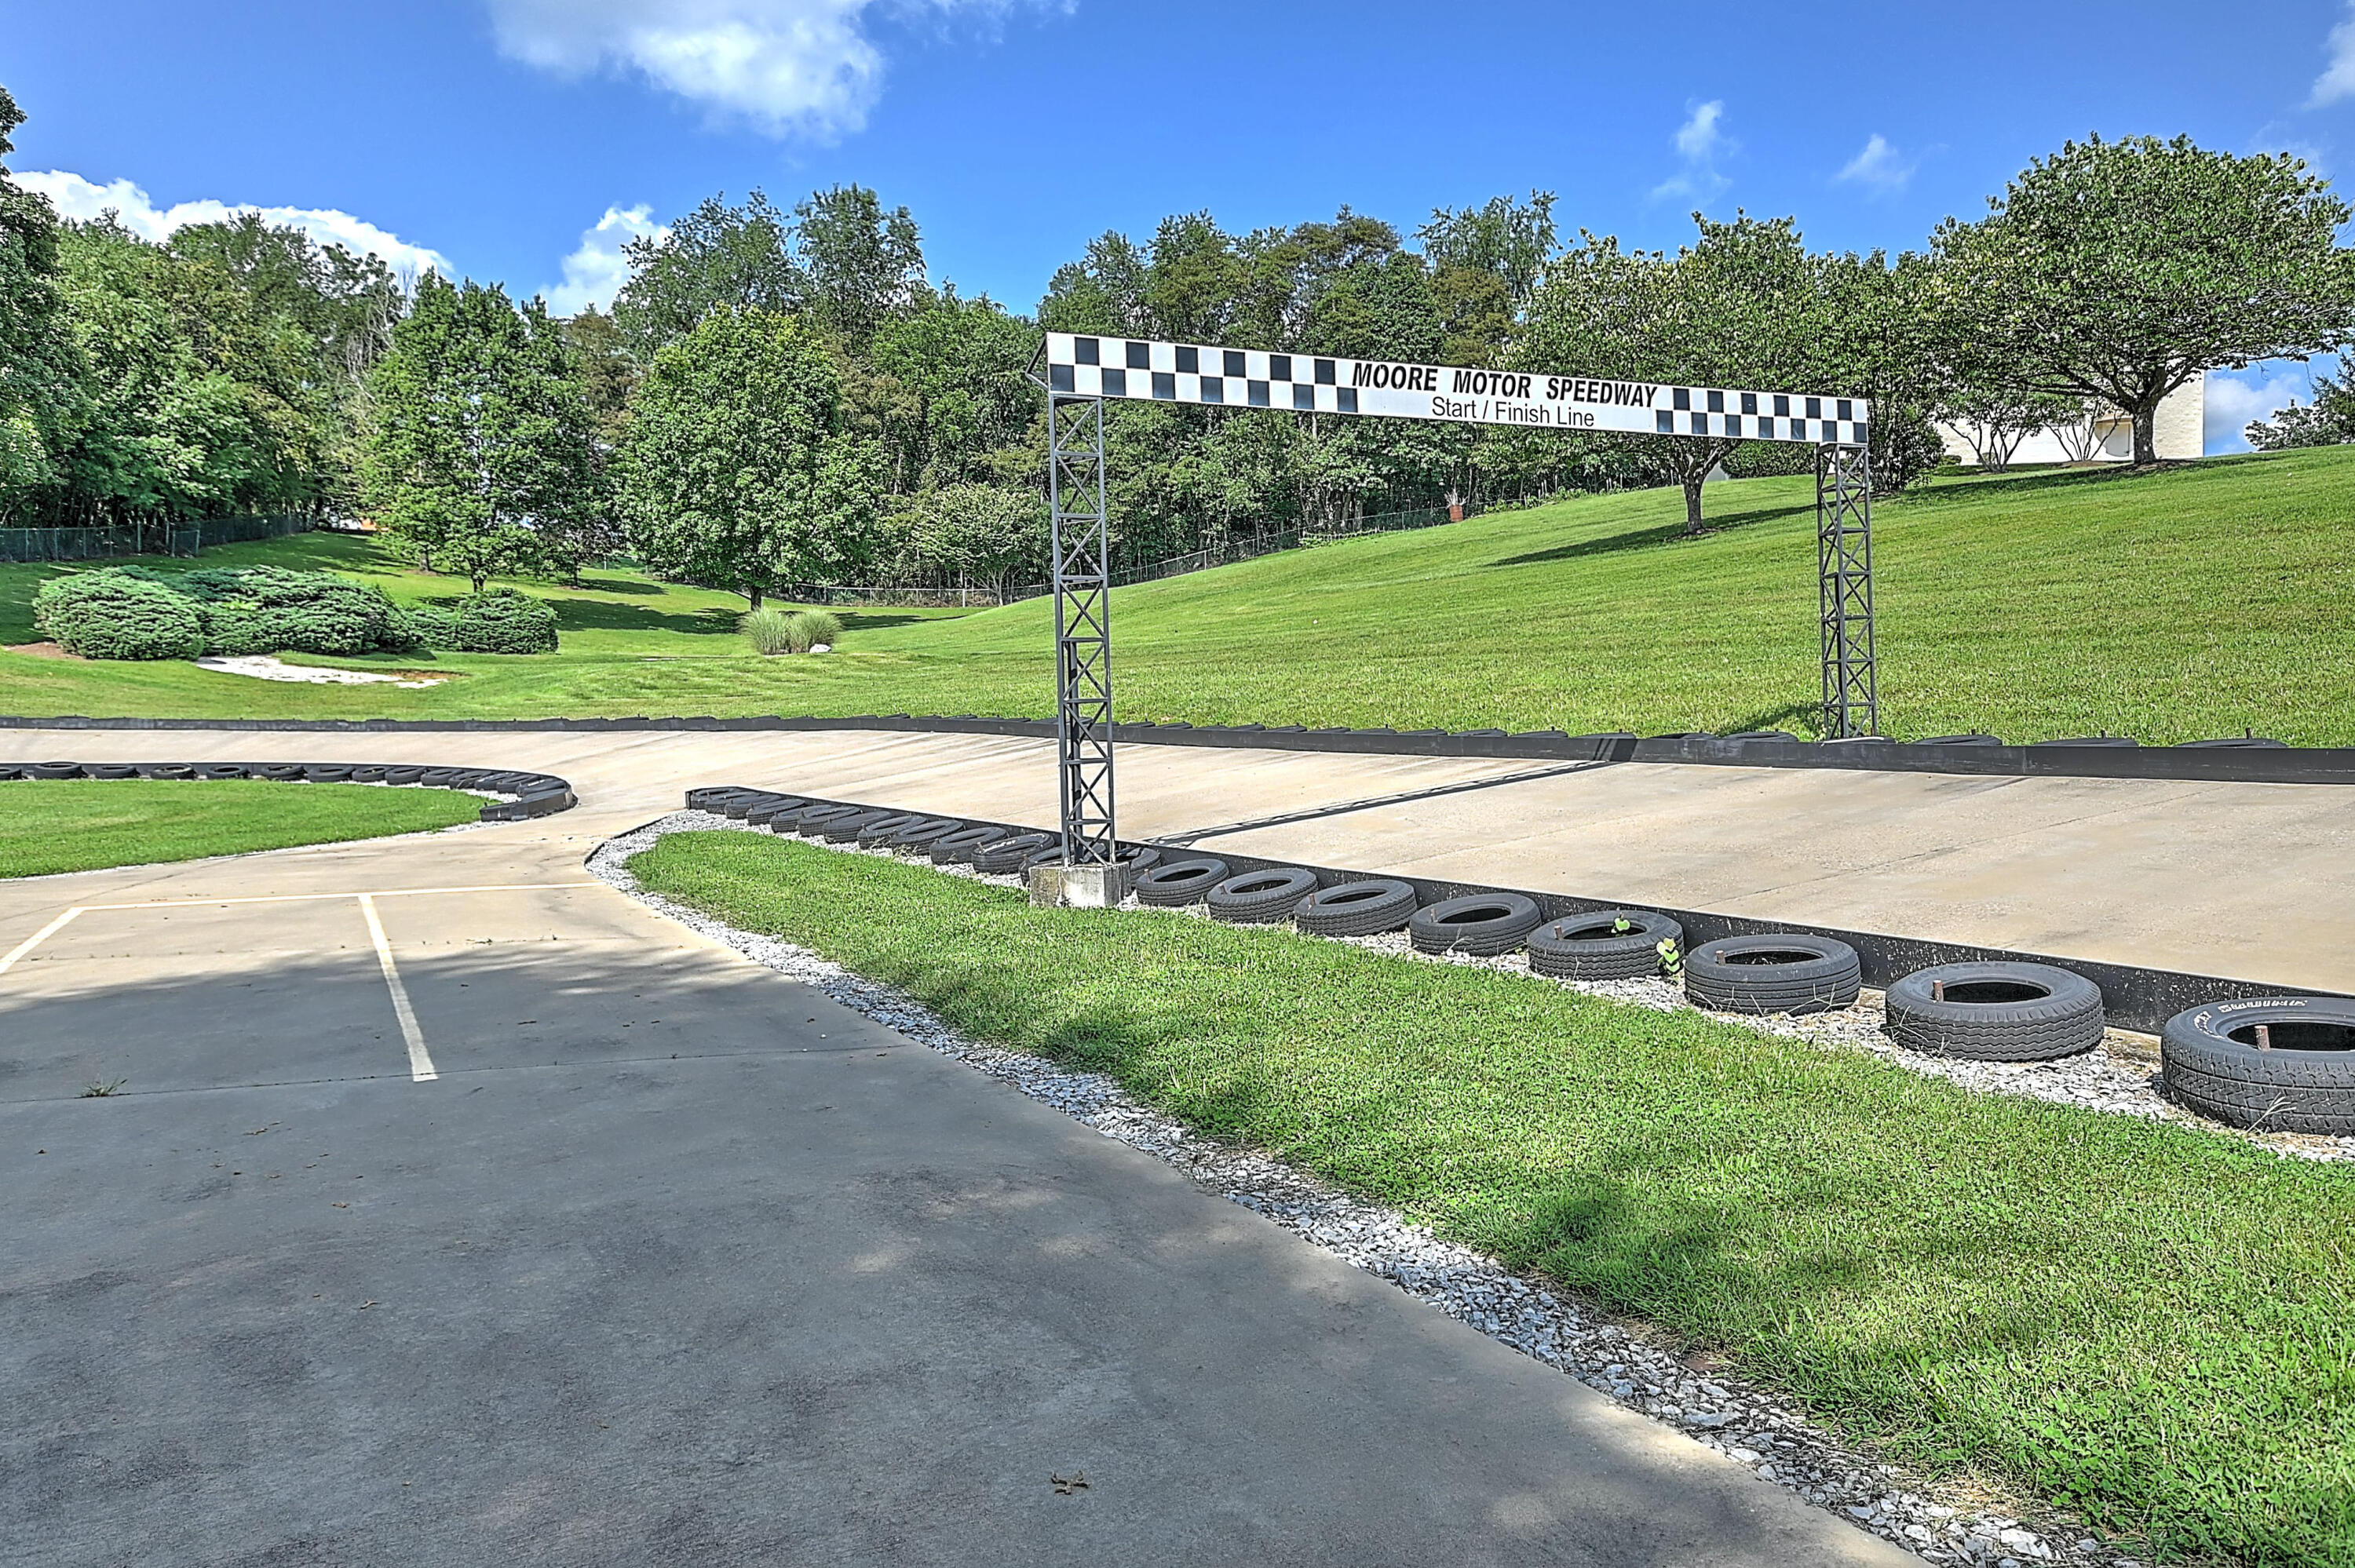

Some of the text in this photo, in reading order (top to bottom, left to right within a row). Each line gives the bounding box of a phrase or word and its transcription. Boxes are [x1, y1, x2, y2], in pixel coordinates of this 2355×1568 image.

[1352, 362, 1658, 408] MOORE MOTOR SPEEDWAY
[1432, 396, 1594, 427] Start / Finish Line
